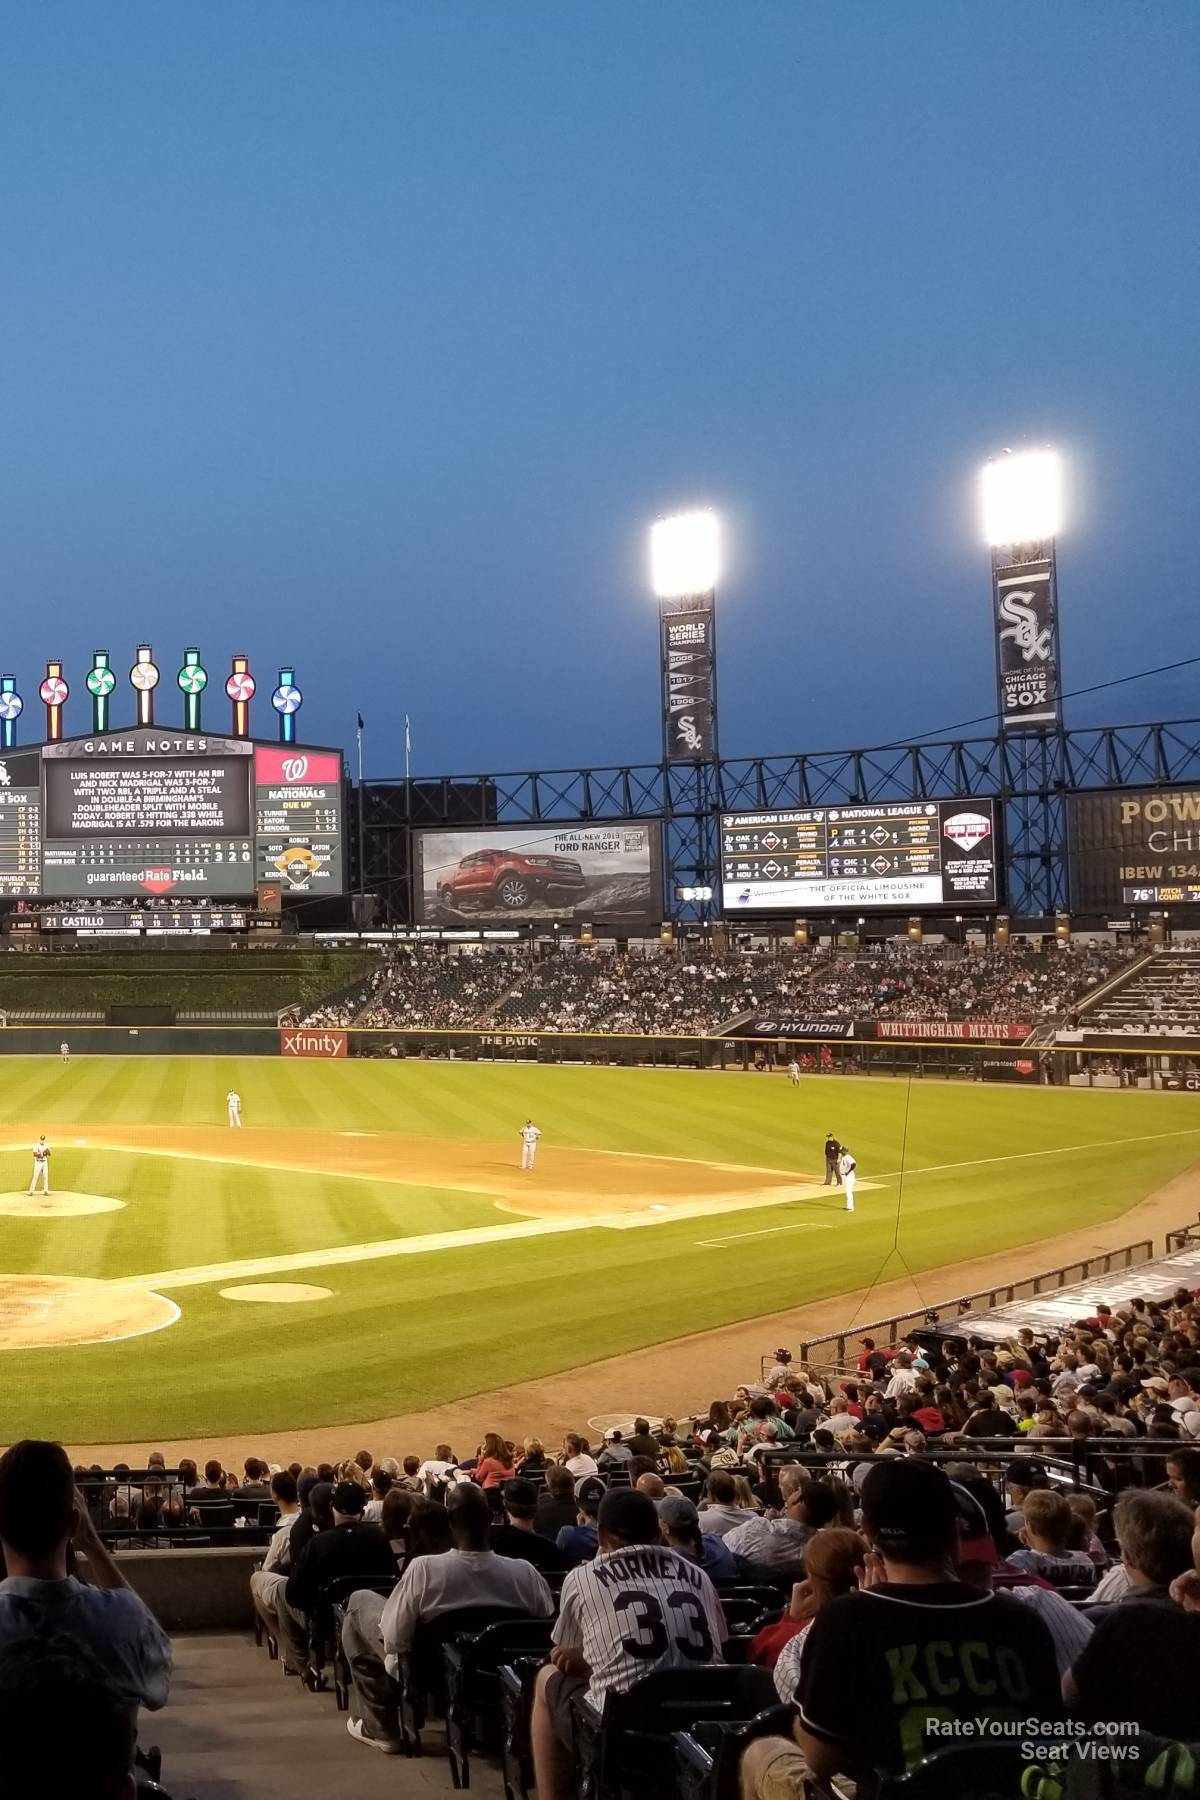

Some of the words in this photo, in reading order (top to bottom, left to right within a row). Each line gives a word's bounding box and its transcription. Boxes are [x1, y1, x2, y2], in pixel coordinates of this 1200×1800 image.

[669, 622, 705, 633] WORLD
[669, 630, 705, 641] SERIES
[669, 638, 705, 646] CHAMPIONS
[1005, 673, 1046, 684] CHICAGO
[1006, 680, 1047, 693] WHITE
[1006, 690, 1047, 707] SOX
[84, 741, 135, 752] GAME
[146, 740, 207, 751] NOTES
[70, 772, 88, 780] LUIS
[121, 771, 140, 779] WAS
[142, 770, 172, 778] 5-FOR-7
[174, 770, 196, 778] WITH
[119, 779, 163, 787] MADRIGAL
[73, 788, 94, 796] WITH
[117, 788, 132, 796] RBI,
[197, 786, 222, 794] STEAL
[268, 790, 326, 799] NATIONALS
[7, 795, 28, 803] SOX
[90, 796, 100, 804] IN
[143, 795, 204, 803] BIRMINGHAM'S
[77, 804, 141, 812] DOUBLEHEADER
[142, 803, 163, 811] SPLIT
[164, 803, 186, 811] WITH
[841, 810, 886, 818] NATIONAL
[887, 807, 922, 815] LEAGUE
[72, 812, 103, 820] TODAY.
[146, 811, 178, 819] HITTING
[735, 815, 778, 825] AMERICAN
[780, 813, 811, 821] LEAGUE
[125, 820, 137, 828] AT
[173, 819, 189, 827] THE
[190, 819, 224, 827] BARONS
[554, 843, 579, 852] FORD
[581, 841, 620, 851] RANGER
[215, 851, 223, 861] 3
[228, 851, 236, 861] 2
[242, 851, 250, 861] 0
[87, 870, 144, 884] guaranteed
[146, 870, 170, 880] Rate
[172, 868, 208, 881] Field.
[1120, 866, 1163, 880] IBEW
[830, 884, 871, 892] OFFICIAL
[1132, 888, 1153, 901] 76°
[46, 917, 57, 926] 21
[62, 917, 104, 927] CASTILLO
[780, 1023, 844, 1033] HYUNDAI
[881, 1022, 965, 1038] WHITTINGHAM
[969, 1024, 1009, 1039] MEATS
[284, 1032, 343, 1057] xfinity
[480, 1036, 503, 1045] THE
[592, 1554, 702, 1589] MORNEAU
[613, 1590, 714, 1661] 33
[885, 1640, 1031, 1704] KCCO
